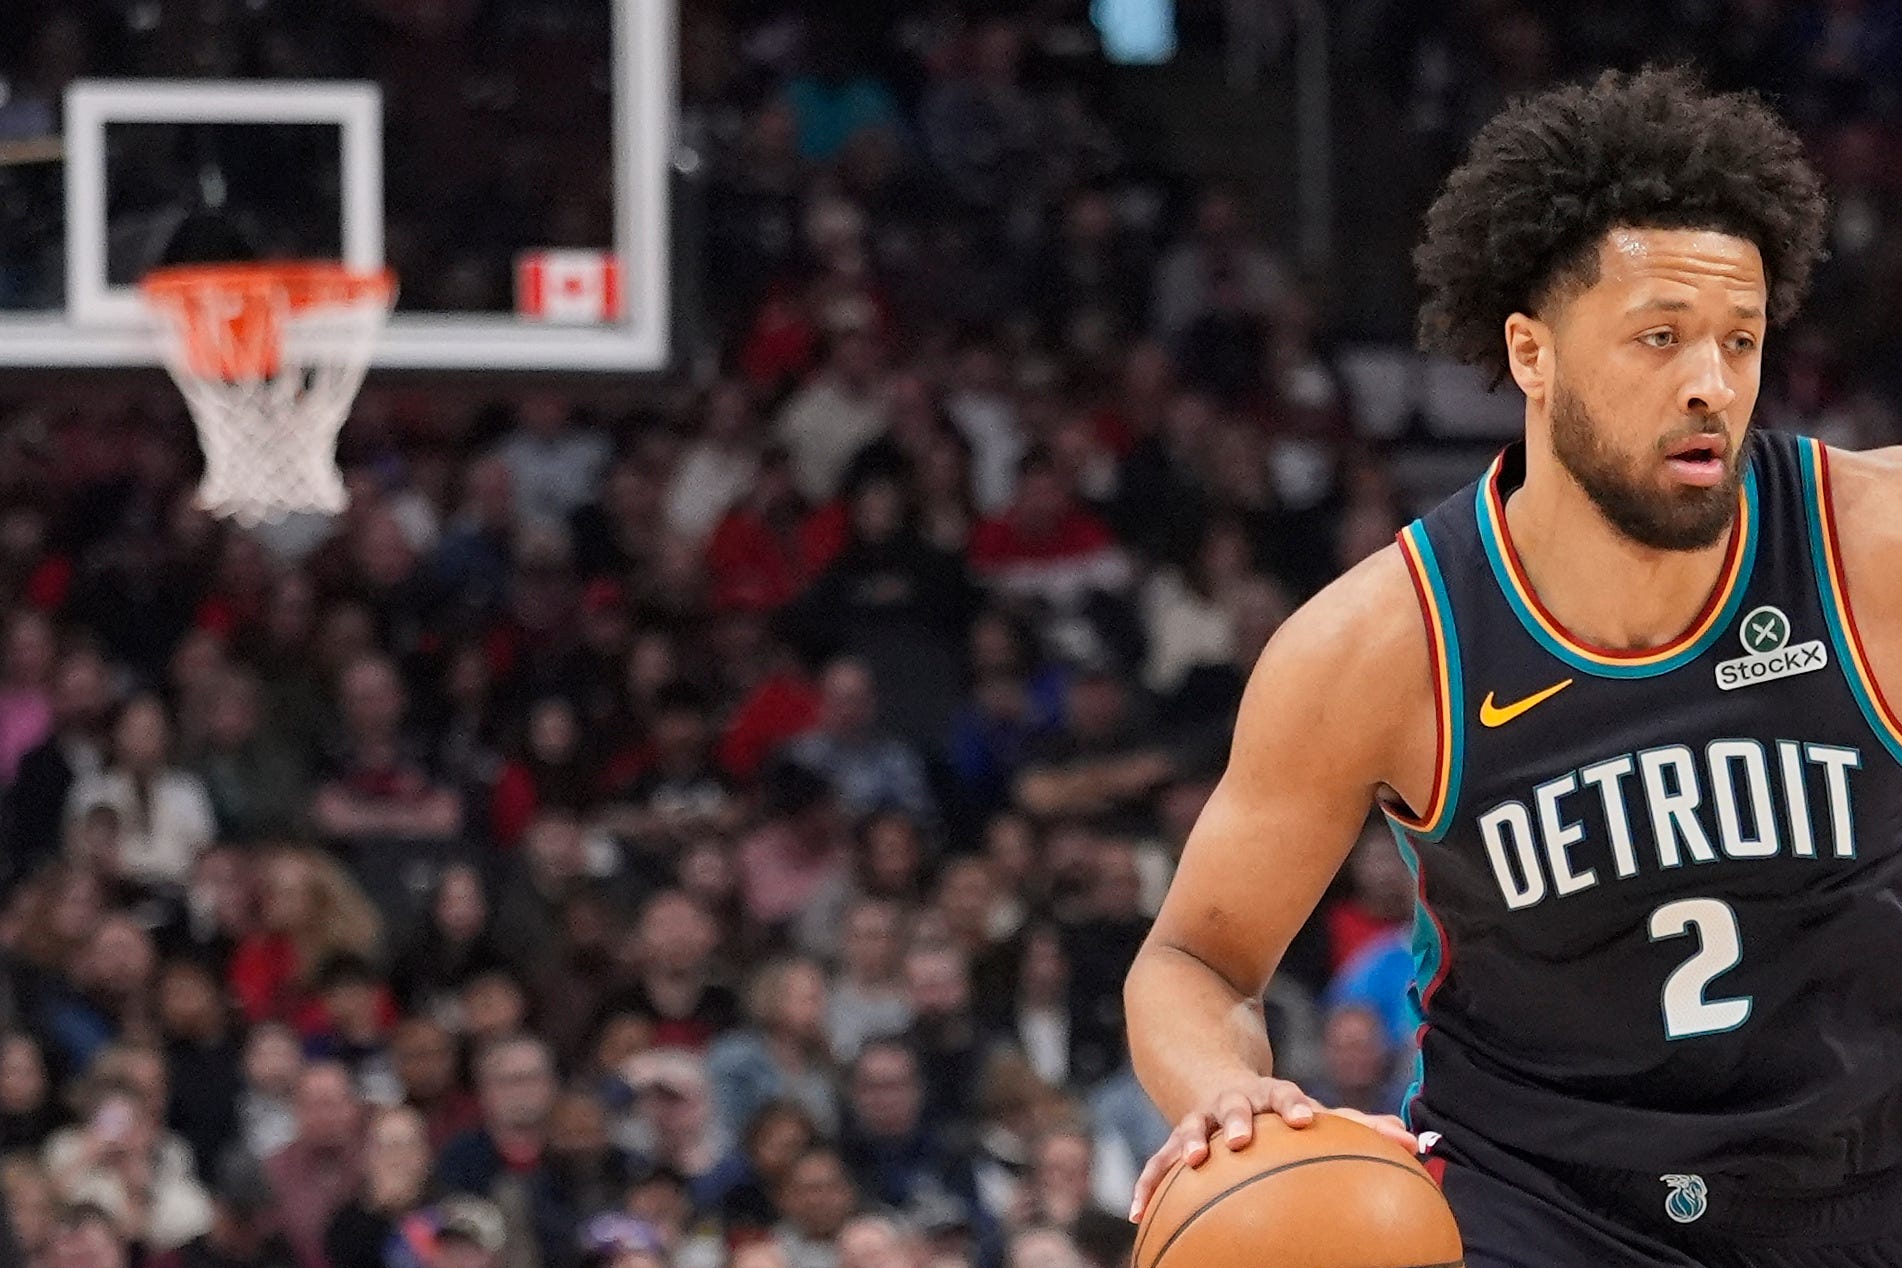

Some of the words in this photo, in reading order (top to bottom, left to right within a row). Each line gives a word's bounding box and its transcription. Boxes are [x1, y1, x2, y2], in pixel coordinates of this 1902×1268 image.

[1720, 644, 1823, 685] StockX
[1476, 738, 1862, 911] DETROIT
[1647, 897, 1754, 1041] 2
